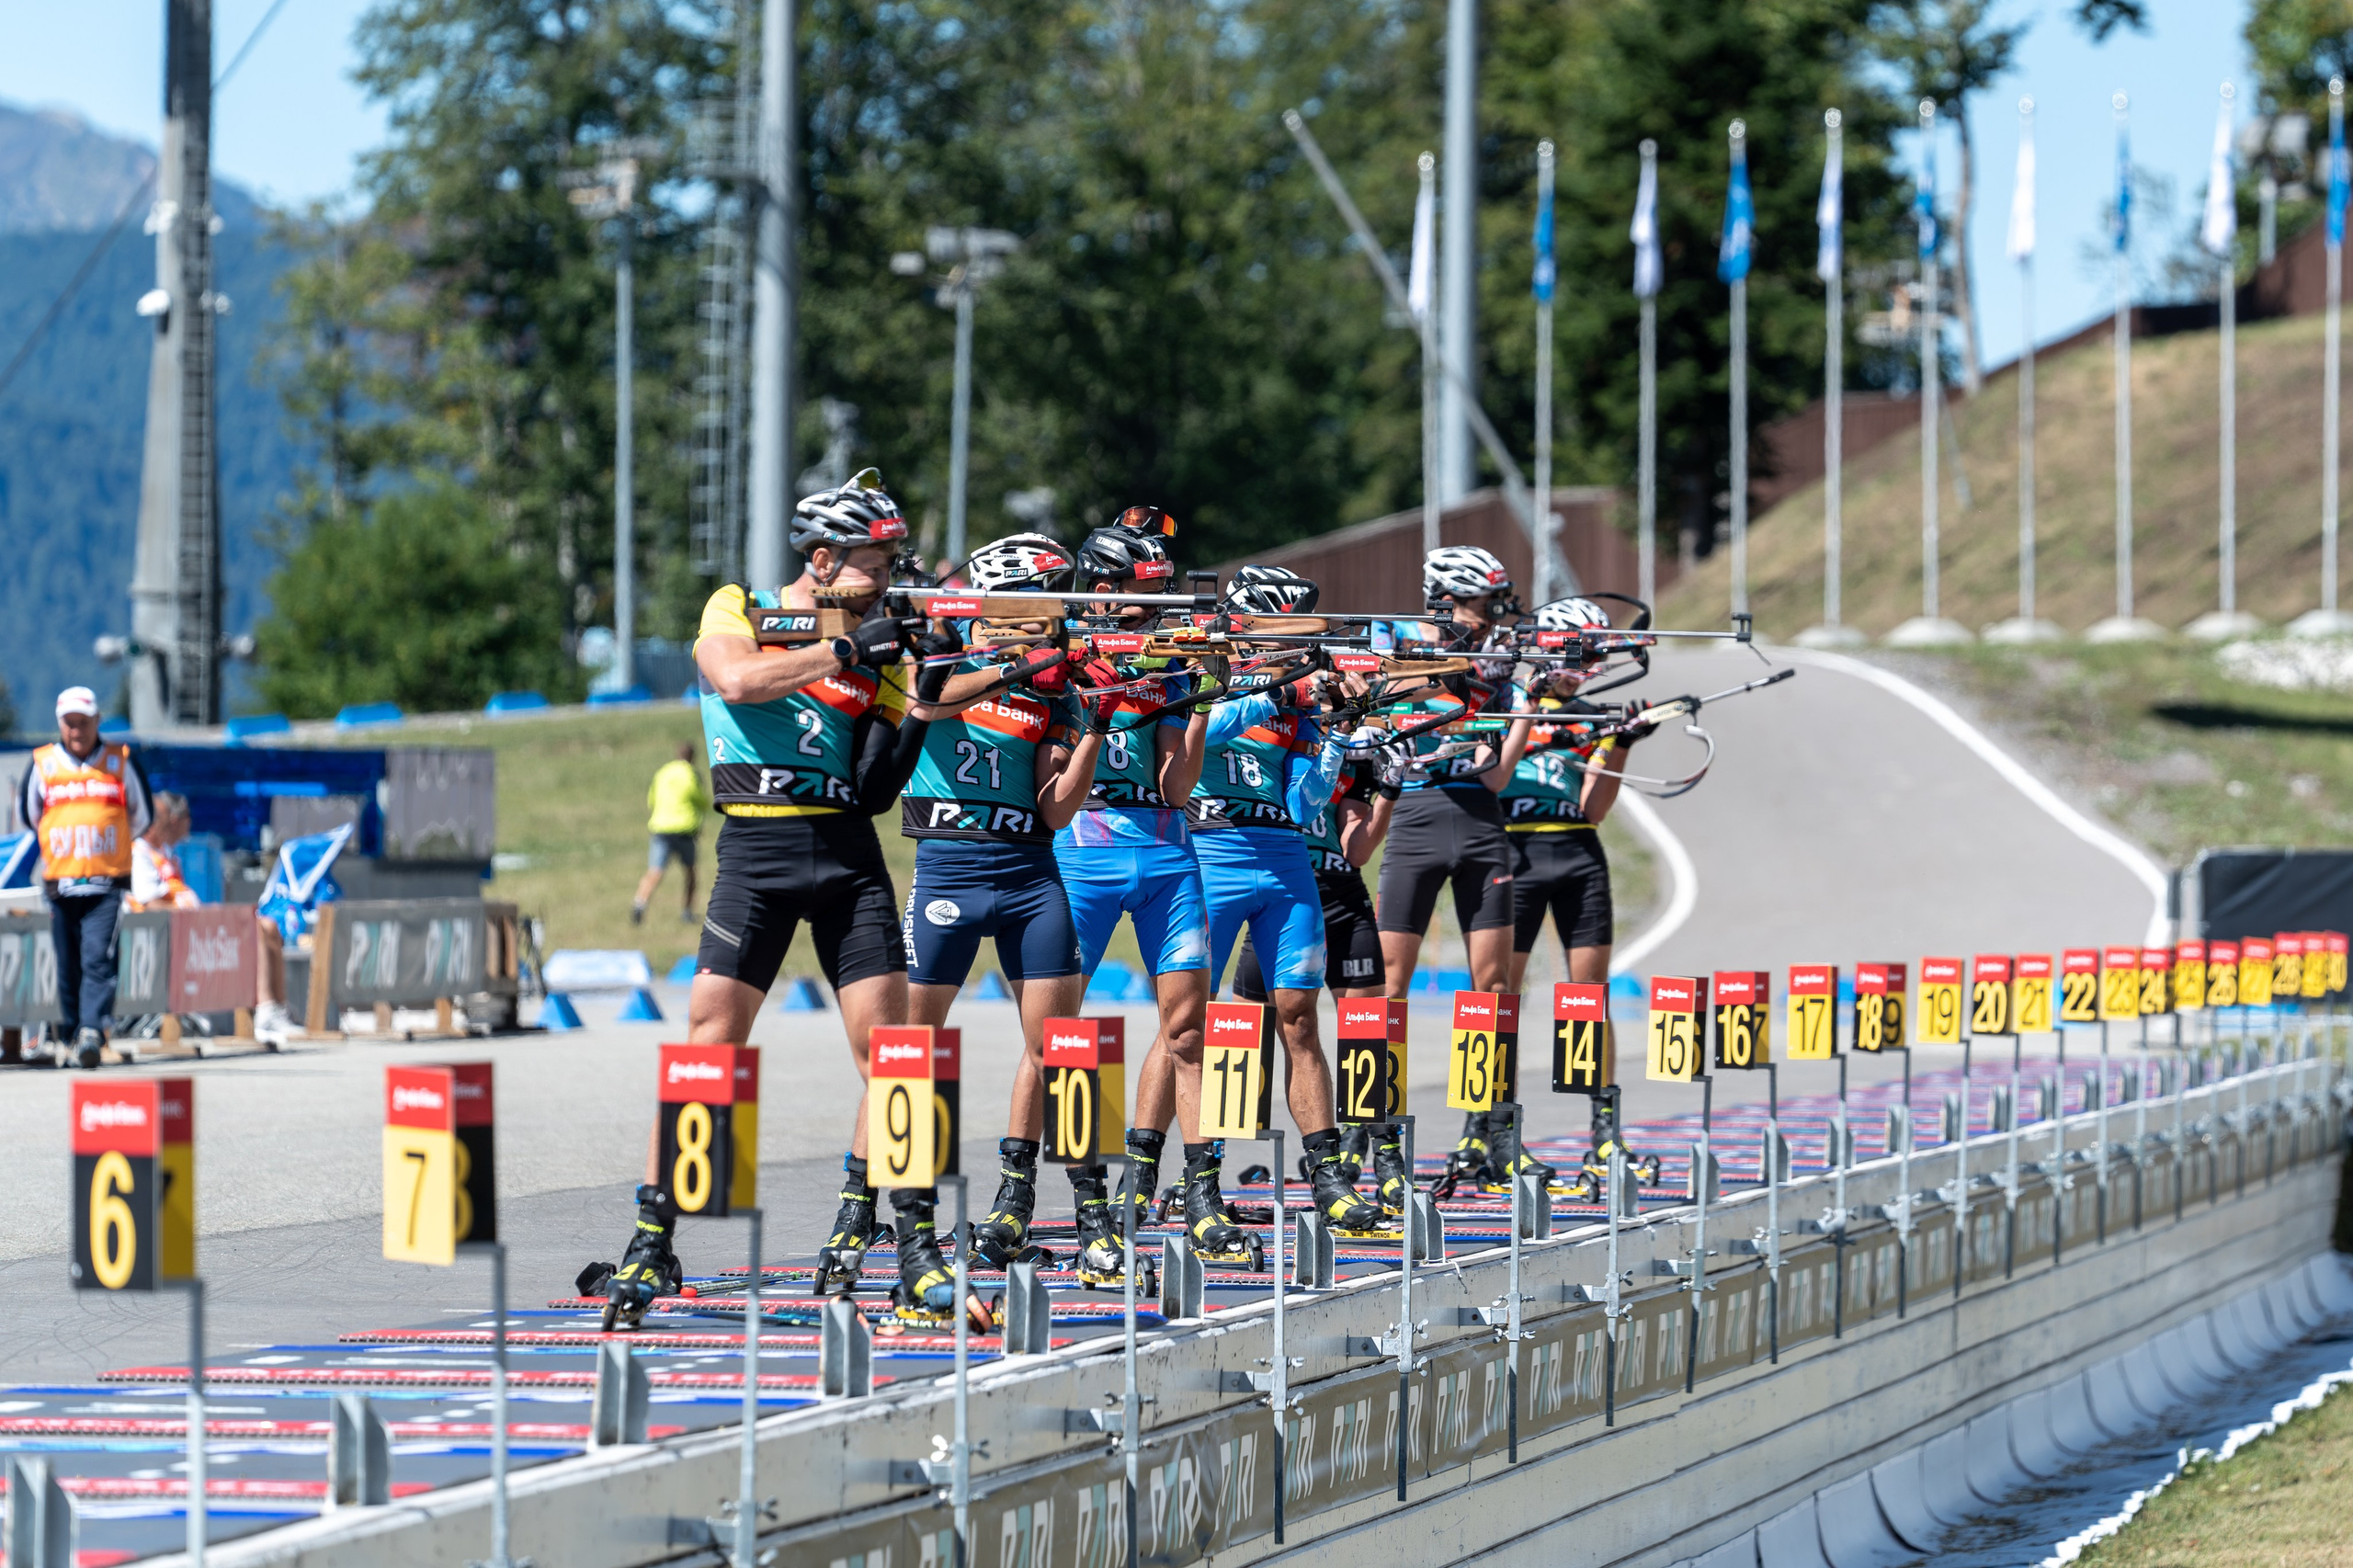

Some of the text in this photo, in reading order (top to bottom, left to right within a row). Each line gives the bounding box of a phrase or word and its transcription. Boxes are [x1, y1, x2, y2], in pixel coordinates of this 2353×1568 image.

[823, 531, 847, 543] PARI
[1005, 568, 1028, 577] PARI
[1093, 566, 1109, 575] PARI
[762, 616, 816, 631] PARI
[931, 601, 976, 613] Альфа Банк
[1097, 638, 1138, 648] Альфа Банк
[1339, 658, 1359, 667] Альфа
[1229, 674, 1271, 687] PARI
[798, 708, 824, 758] 2
[996, 699, 1045, 731] Банк
[1262, 717, 1292, 736] анк
[713, 737, 726, 762] 2
[955, 738, 1002, 790] 21
[1105, 726, 1131, 771] 8
[1220, 747, 1263, 789] 18
[1532, 755, 1567, 790] 12
[928, 801, 1035, 835] PARI
[49, 824, 118, 859] СУДЬЯ
[1342, 958, 1375, 977] BLR
[1460, 1005, 1491, 1017] Альфа Банк
[1927, 987, 1955, 1037] 19
[1972, 980, 2007, 1034] 20
[2021, 981, 2046, 1027] 21
[2062, 971, 2097, 1021] 22
[2105, 971, 2138, 1014] 23
[2139, 968, 2166, 1014] 24
[1099, 1034, 1117, 1045] анк
[1213, 1017, 1253, 1033] Альфа Банк
[1345, 1012, 1381, 1025] Альфа Банк
[1717, 1004, 1752, 1066] 16
[1797, 997, 1825, 1051] 17
[1856, 992, 1884, 1051] 18
[1884, 997, 1903, 1044] 9
[1051, 1034, 1090, 1051] Альфа Банк
[1558, 1018, 1597, 1086] 14
[1655, 1013, 1687, 1076] 15
[1213, 1049, 1250, 1130] 11
[1341, 1049, 1377, 1119] 12
[1457, 1031, 1489, 1104] 13
[1493, 1043, 1508, 1103] 4
[887, 1084, 912, 1176] 9
[1049, 1067, 1092, 1160] 10
[672, 1100, 713, 1213] 8
[1000, 1167, 1026, 1180] CHER
[1196, 1166, 1221, 1179] FISCH
[89, 1149, 137, 1290] 6
[404, 1150, 427, 1249] 7
[1083, 1198, 1108, 1207] FISCH
[914, 1221, 936, 1232] FISC
[1483, 1356, 1510, 1437] PA
[1529, 1338, 1563, 1421] PARI
[1383, 1381, 1424, 1471] PRI
[1434, 1367, 1472, 1455] PARI
[1283, 1412, 1316, 1507] ARI
[1329, 1396, 1371, 1489] PARI
[1214, 1430, 1258, 1532] PARI
[1074, 1475, 1129, 1568] PARI
[1149, 1454, 1202, 1558] PARI
